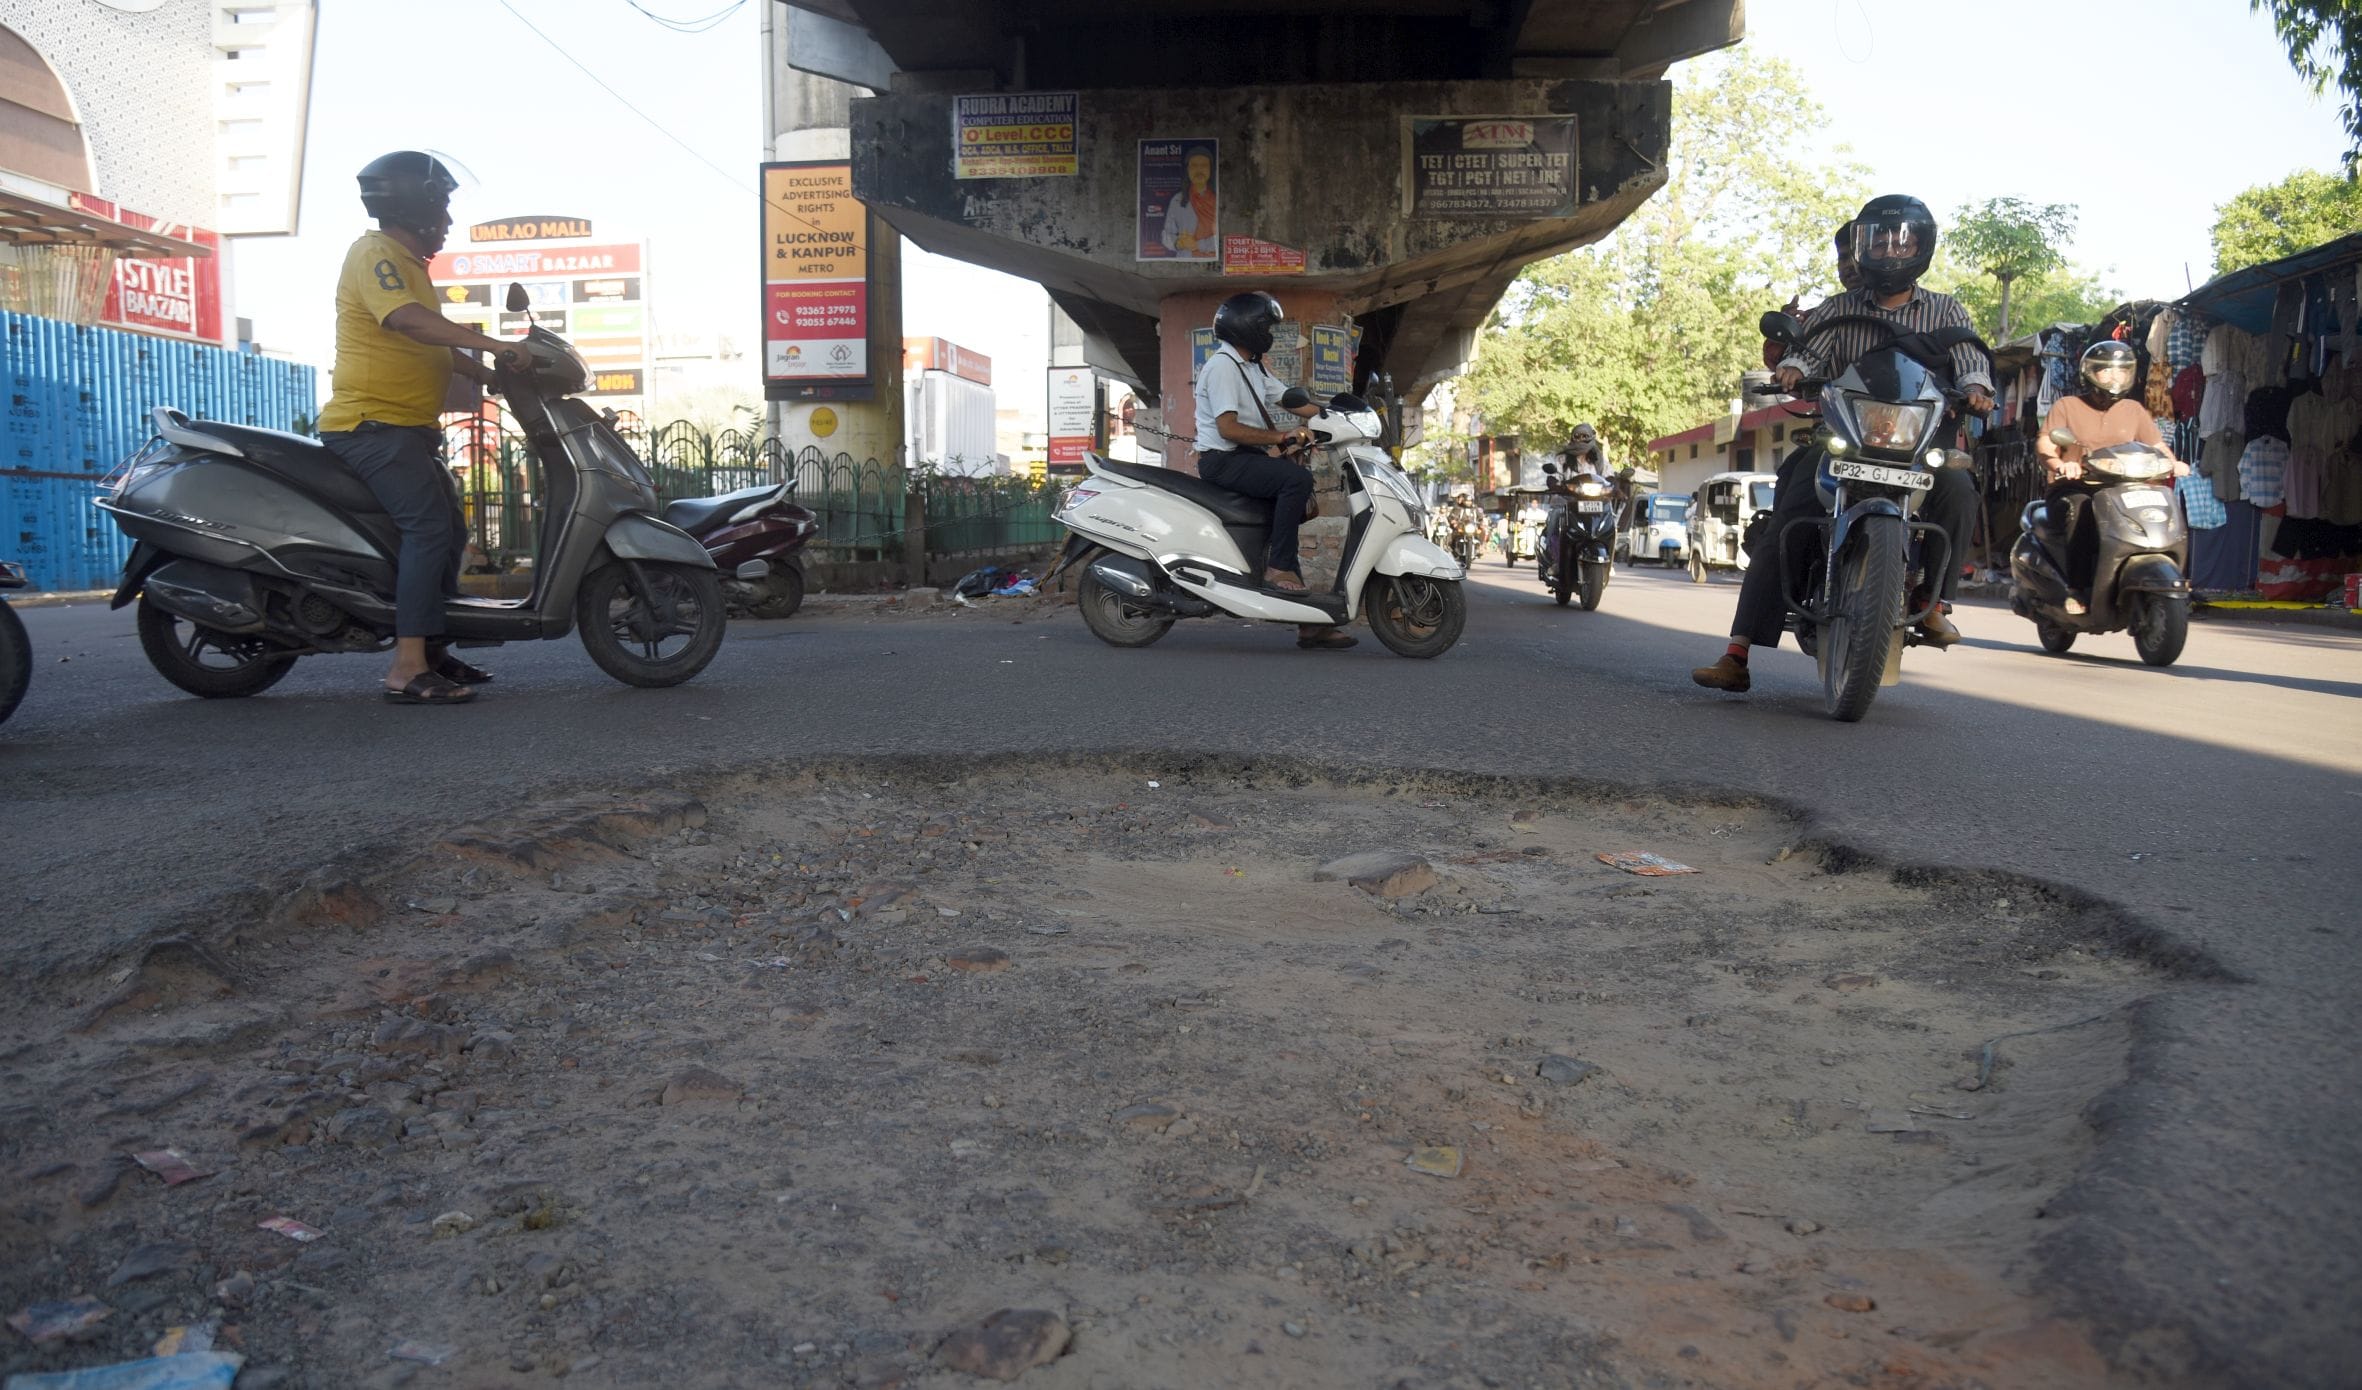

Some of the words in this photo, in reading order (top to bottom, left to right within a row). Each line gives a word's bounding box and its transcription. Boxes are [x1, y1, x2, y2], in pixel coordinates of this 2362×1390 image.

[961, 98, 1007, 115] RUDRA
[1009, 95, 1074, 114] ACADEMY
[962, 116, 1014, 126] COMPUTER
[1017, 114, 1073, 124] EDUCATION
[1471, 124, 1526, 139] AIM
[1420, 155, 1444, 168] TET
[1455, 155, 1488, 168] CTET
[1499, 153, 1542, 167] SUPER
[1545, 152, 1569, 167] TET
[789, 177, 843, 187] EXCLUSIVE
[1428, 172, 1455, 185] TGT
[1465, 171, 1492, 185] PGT
[1503, 170, 1528, 184] NET
[1537, 169, 1562, 184] JRF
[783, 190, 850, 200] ADVERTISING
[797, 203, 835, 213] RIGHTS
[471, 223, 537, 241] UMRAO
[540, 221, 591, 237] MALL
[777, 231, 854, 244] LUCKNOW
[777, 248, 787, 259] &
[792, 246, 856, 258] KANPUR
[473, 254, 541, 275] SMART
[543, 255, 613, 271] BAZAAR
[798, 264, 835, 273] METRO
[124, 258, 189, 300] STYLE
[375, 259, 405, 290] 8
[126, 290, 190, 323] BAAZAR
[795, 306, 825, 315] 93362
[827, 305, 856, 314] 37978
[795, 318, 825, 327] 93055
[827, 317, 856, 326] 67446
[596, 374, 635, 390] WOK
[1833, 462, 1861, 478] UP32
[1872, 468, 1889, 482] GJ
